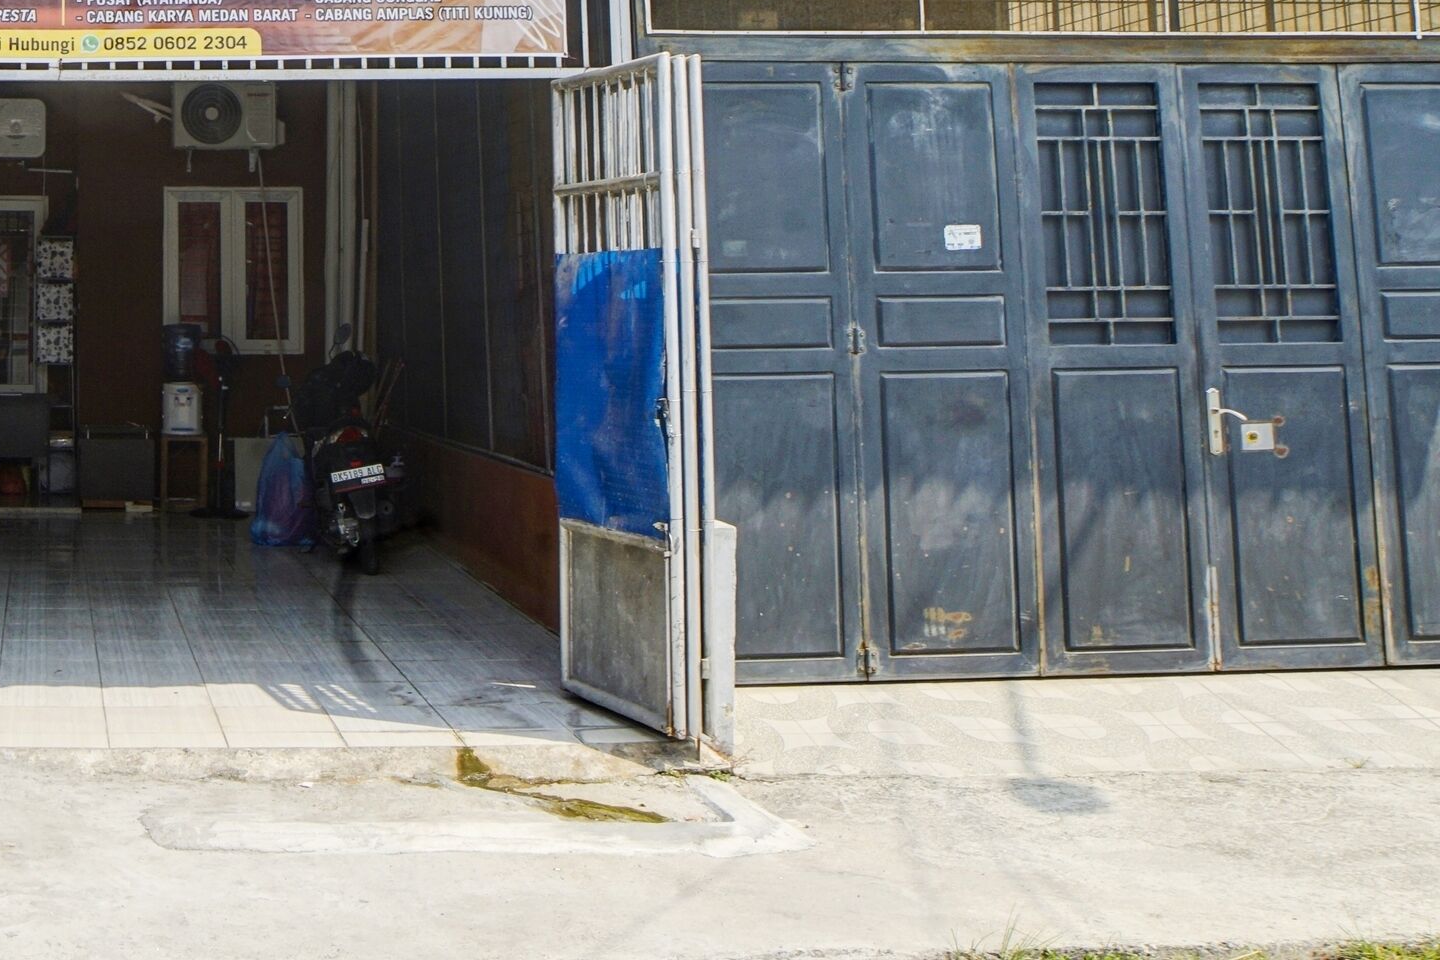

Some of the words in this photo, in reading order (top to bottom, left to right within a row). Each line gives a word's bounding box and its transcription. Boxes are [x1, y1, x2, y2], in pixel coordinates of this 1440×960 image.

[86, 10, 144, 23] CABANG
[148, 10, 194, 23] KARYA
[203, 9, 249, 22] MEDAN
[253, 8, 298, 21] BARAT
[315, 8, 372, 21] CABANG
[376, 7, 434, 20] AMPLAS
[438, 6, 469, 21] (TITI
[474, 5, 534, 20] KUNING)
[9, 37, 75, 54] Hubungi
[103, 36, 147, 50] 0852
[153, 36, 197, 50] 0602
[203, 35, 247, 49] 2304
